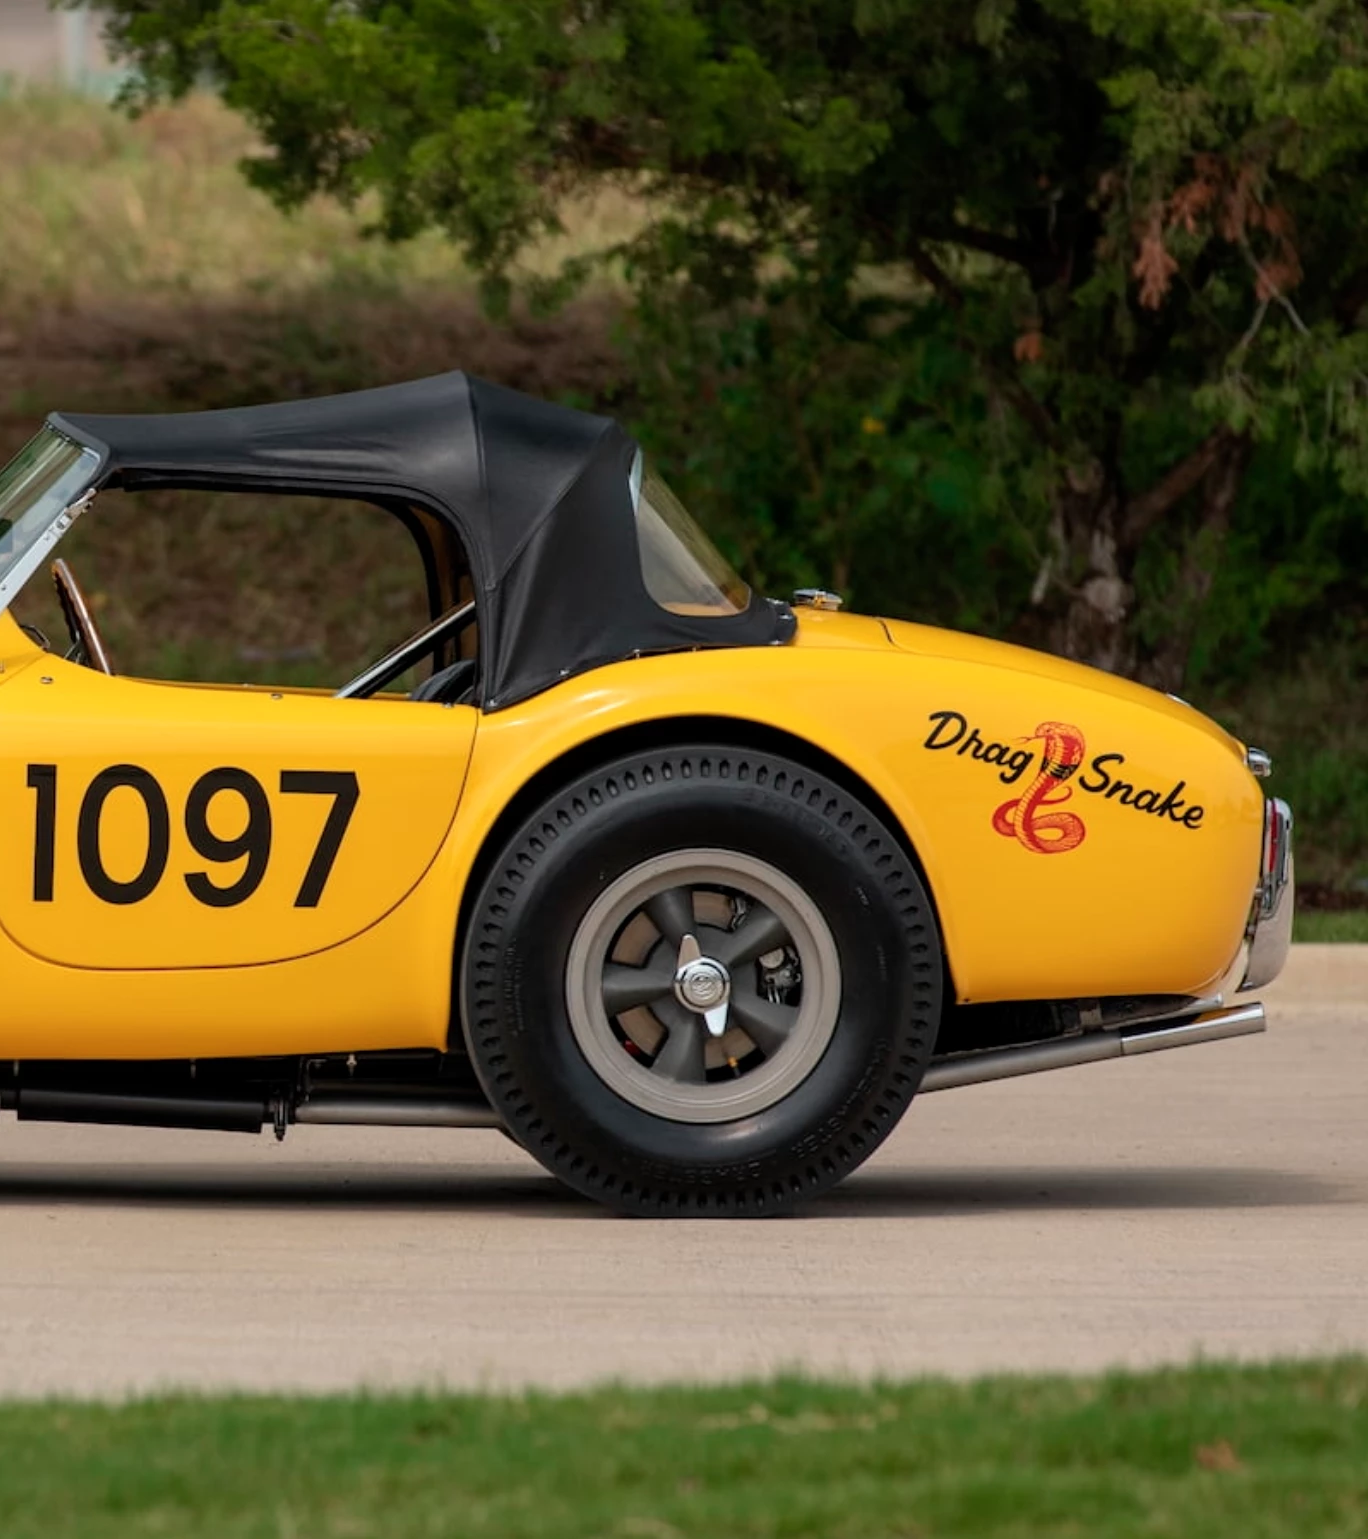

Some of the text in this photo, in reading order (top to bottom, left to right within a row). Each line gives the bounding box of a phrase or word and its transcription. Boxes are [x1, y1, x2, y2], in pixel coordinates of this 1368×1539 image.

[26, 763, 361, 908] 1097
[923, 711, 1204, 829] Drag Snake
